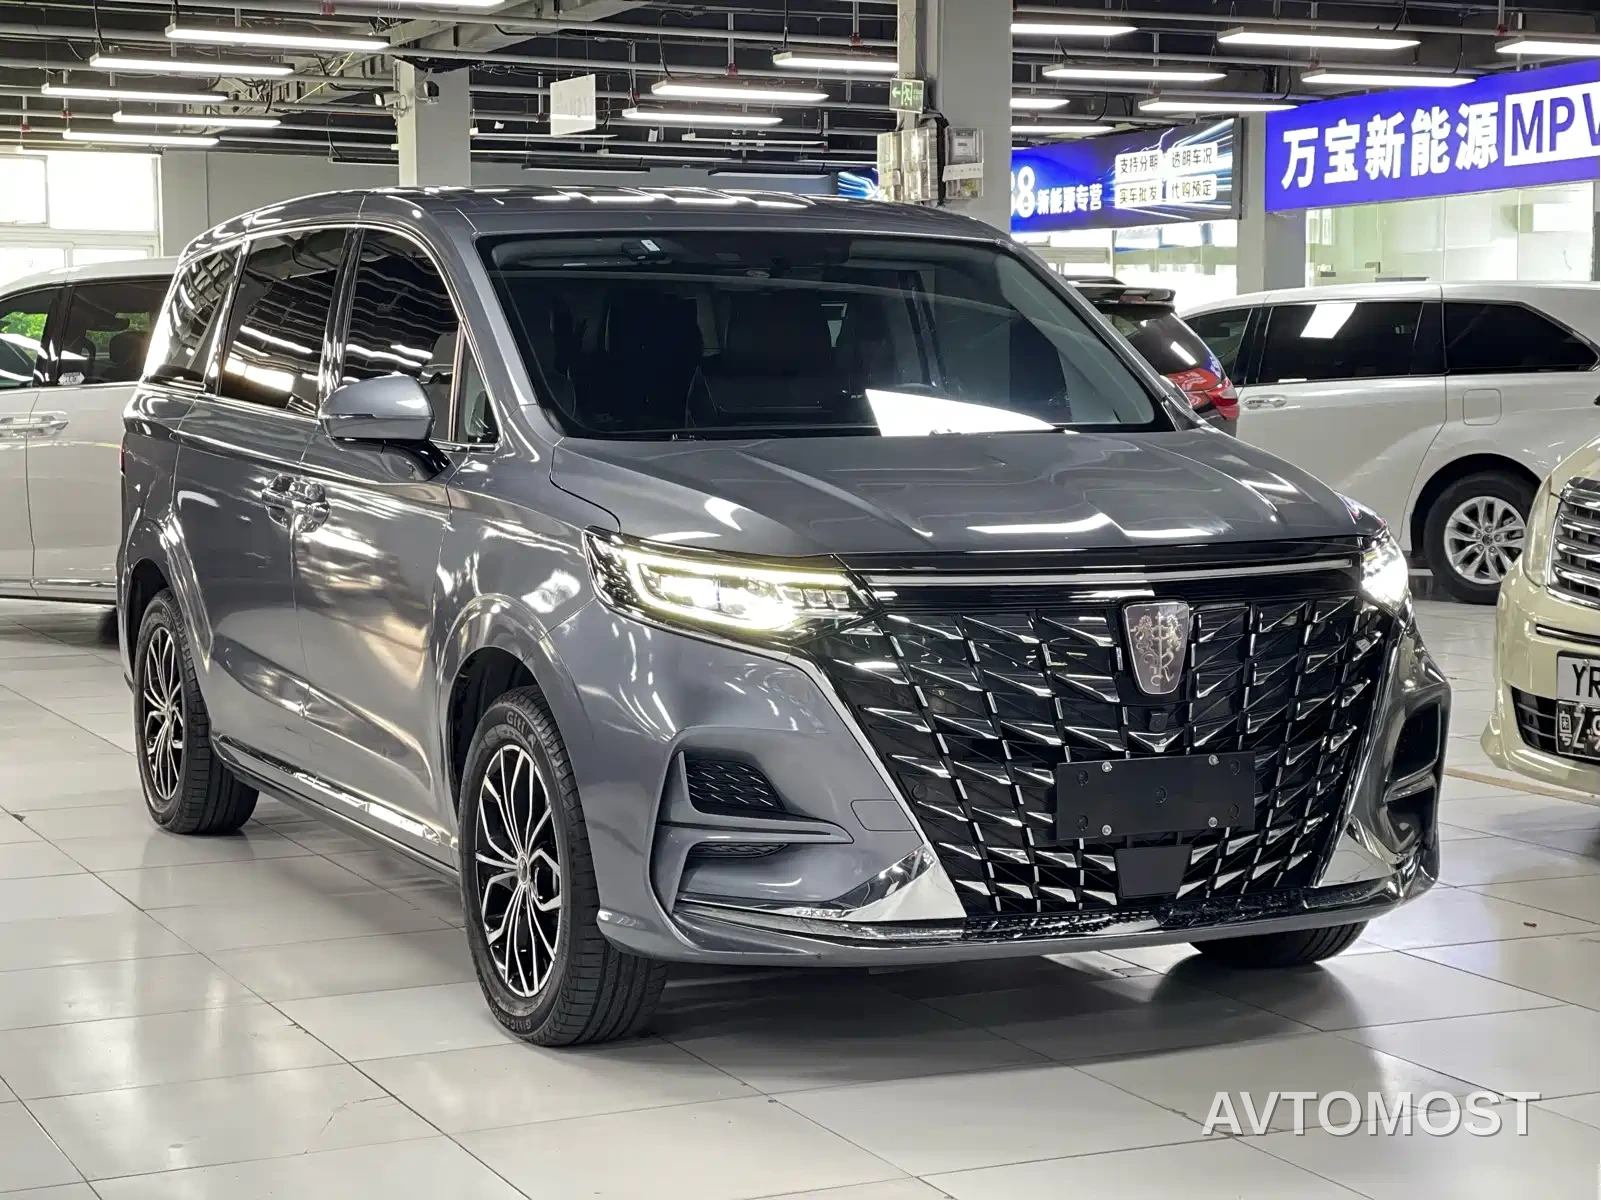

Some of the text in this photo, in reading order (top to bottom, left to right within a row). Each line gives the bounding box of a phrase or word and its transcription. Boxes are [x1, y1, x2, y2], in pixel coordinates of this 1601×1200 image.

[1281, 101, 1499, 190] 万宝新能源
[1119, 154, 1158, 174] 支持分期
[1171, 147, 1212, 168] 透明车况
[1119, 185, 1157, 205] 实车批发
[1171, 179, 1212, 199] 代购预定
